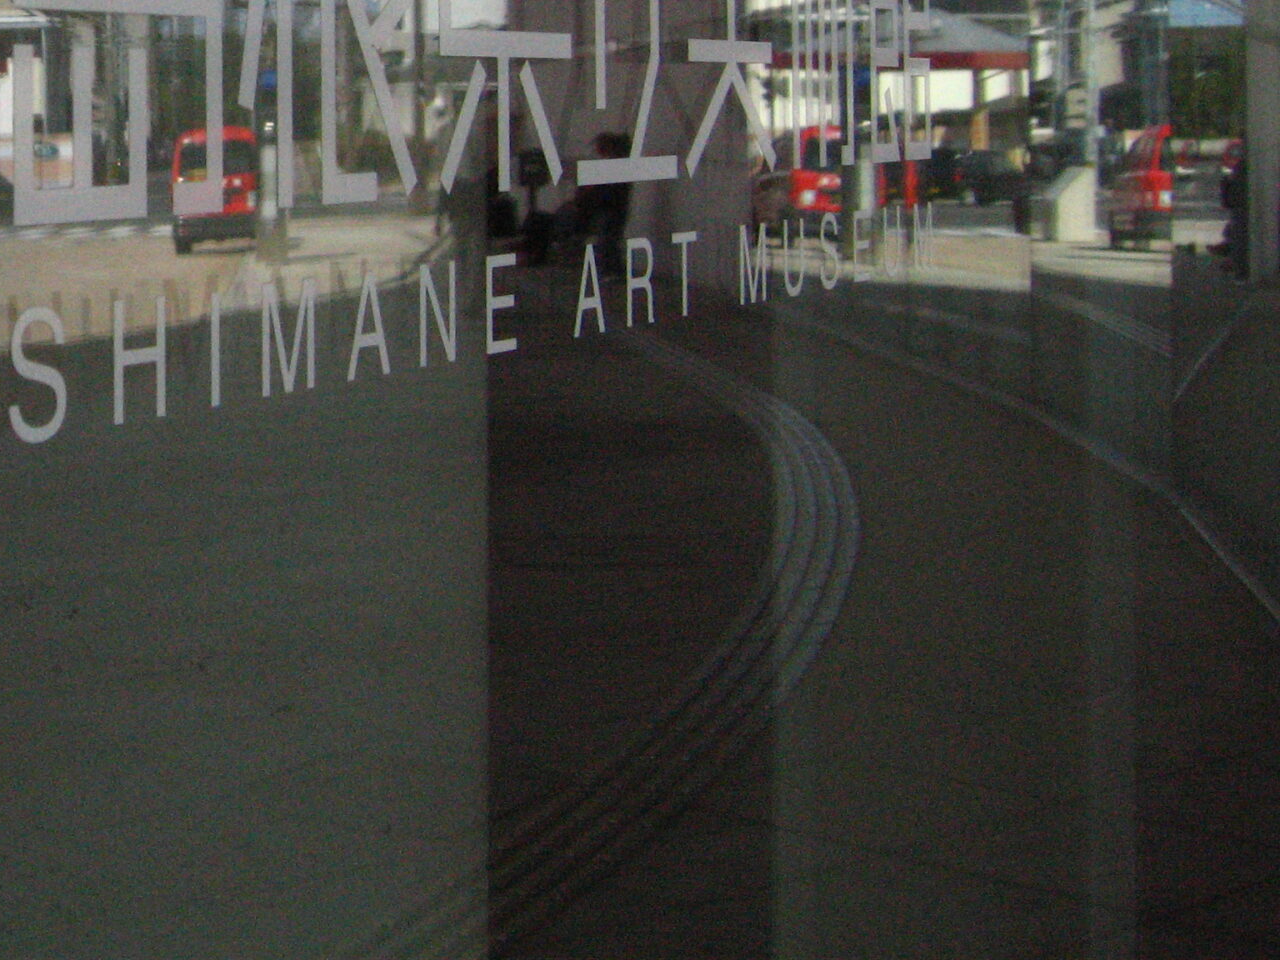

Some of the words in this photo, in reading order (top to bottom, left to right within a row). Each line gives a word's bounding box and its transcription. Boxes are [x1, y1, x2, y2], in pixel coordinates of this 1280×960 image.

[9, 253, 518, 442] SHIMANE
[573, 231, 697, 338] ART
[739, 202, 934, 306] MUSEUM
